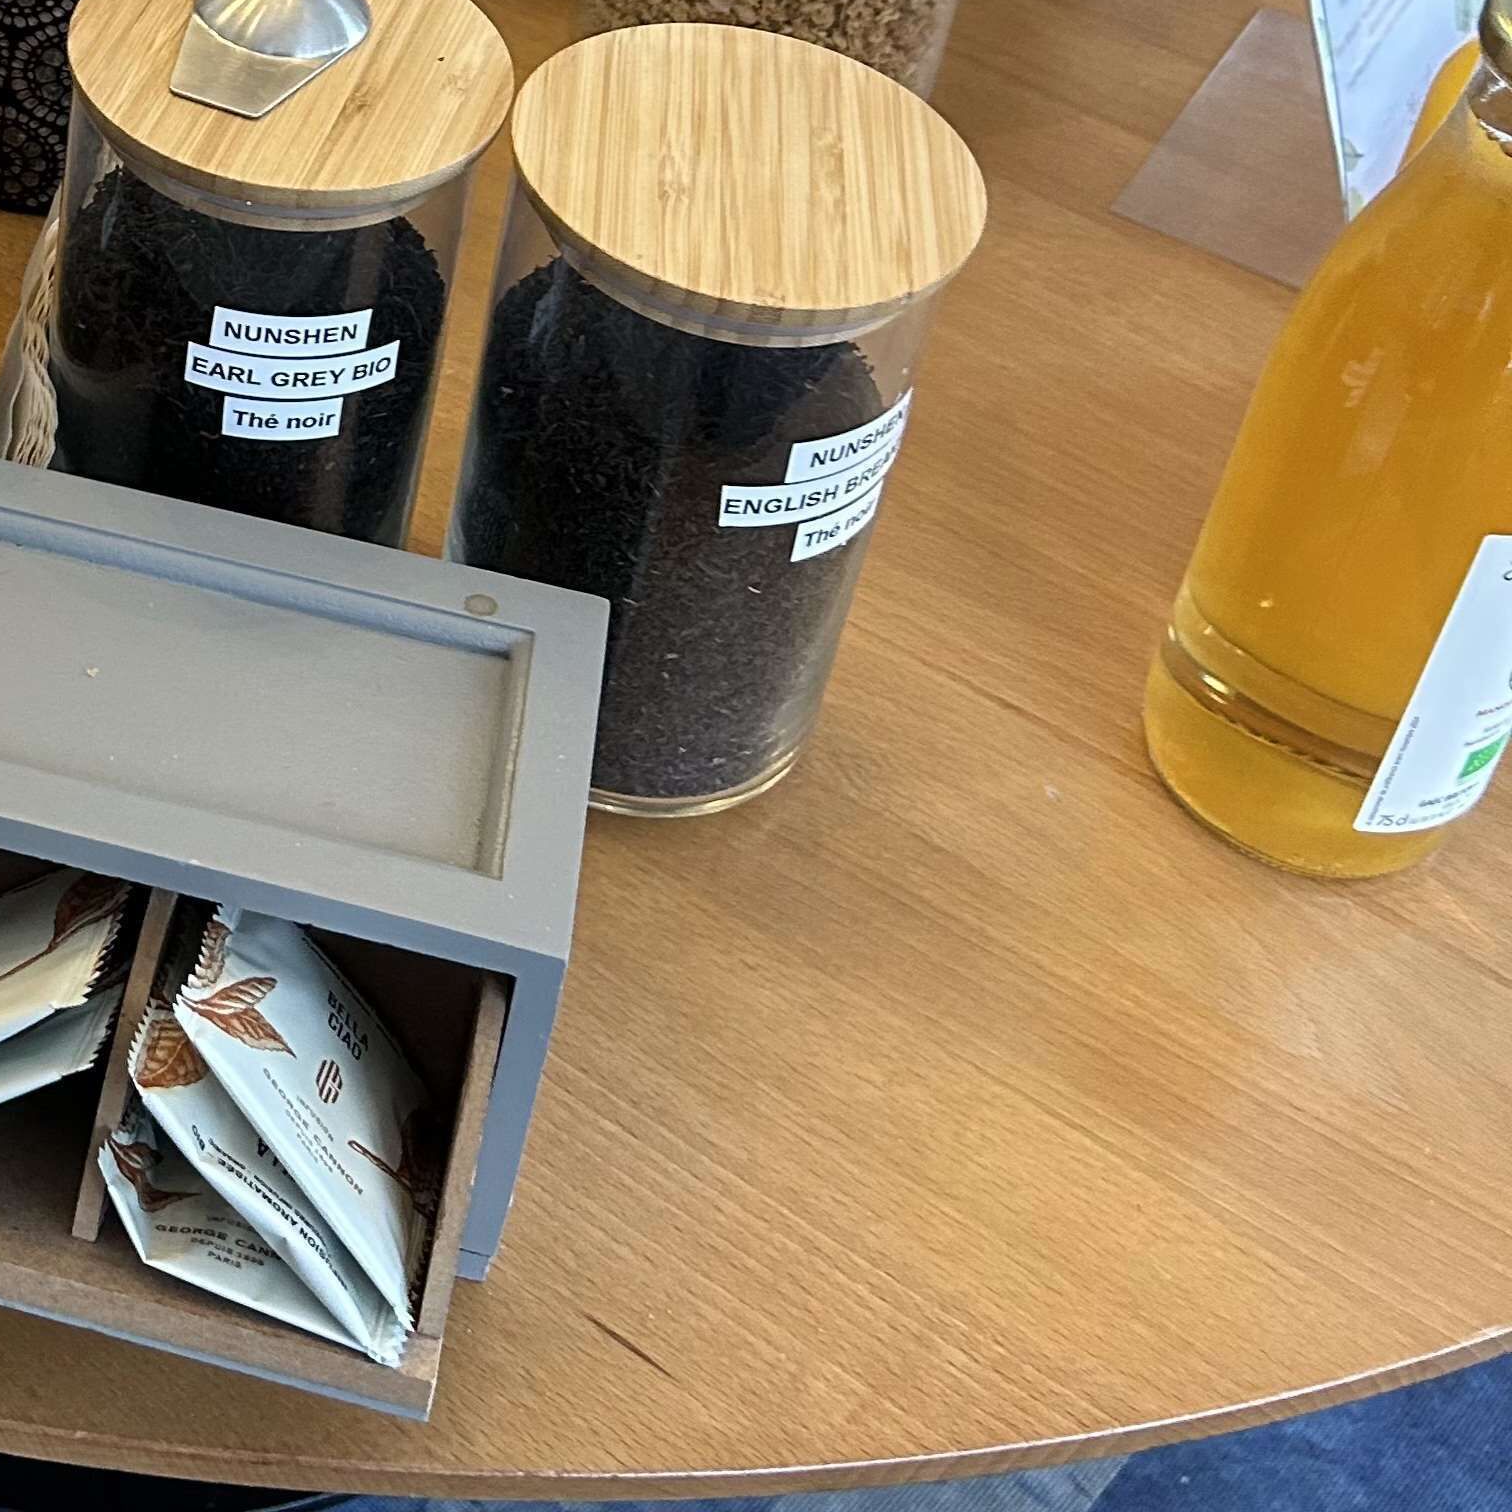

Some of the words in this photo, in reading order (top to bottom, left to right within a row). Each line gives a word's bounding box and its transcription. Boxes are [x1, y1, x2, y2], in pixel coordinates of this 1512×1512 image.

[223, 321, 358, 345] NUNSHEN
[191, 356, 261, 386] EARL
[271, 368, 346, 388] GREY
[352, 357, 391, 381] BIO
[232, 409, 279, 429] Thé
[287, 413, 336, 429] noir
[723, 485, 839, 515] ENGLISH
[327, 990, 369, 1052] BELLA
[327, 1012, 362, 1061] CIAO
[155, 1224, 227, 1241] GEORGE
